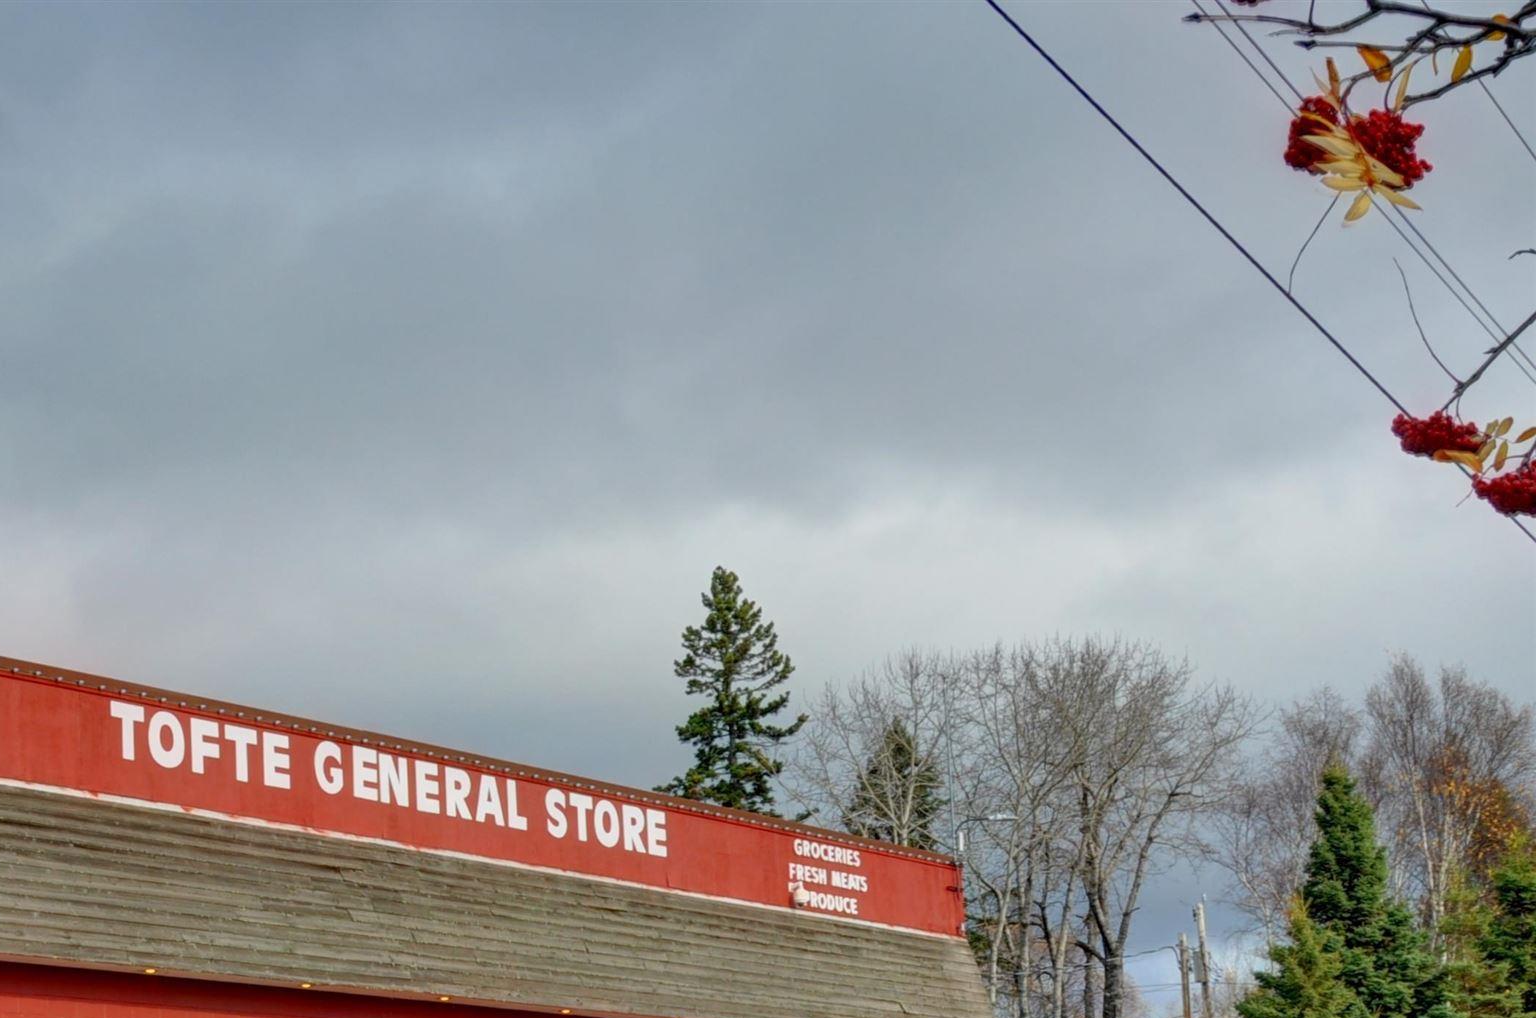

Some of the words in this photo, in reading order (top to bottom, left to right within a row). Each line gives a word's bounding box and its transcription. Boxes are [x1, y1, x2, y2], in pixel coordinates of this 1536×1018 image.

[110, 700, 291, 790] TOFTE
[314, 741, 528, 832] GENERAL
[545, 788, 668, 858] STORE
[794, 838, 861, 867] GROCERIES
[788, 862, 827, 885] FRESH
[831, 870, 868, 893] MEATS
[803, 890, 859, 915] RODUCE
